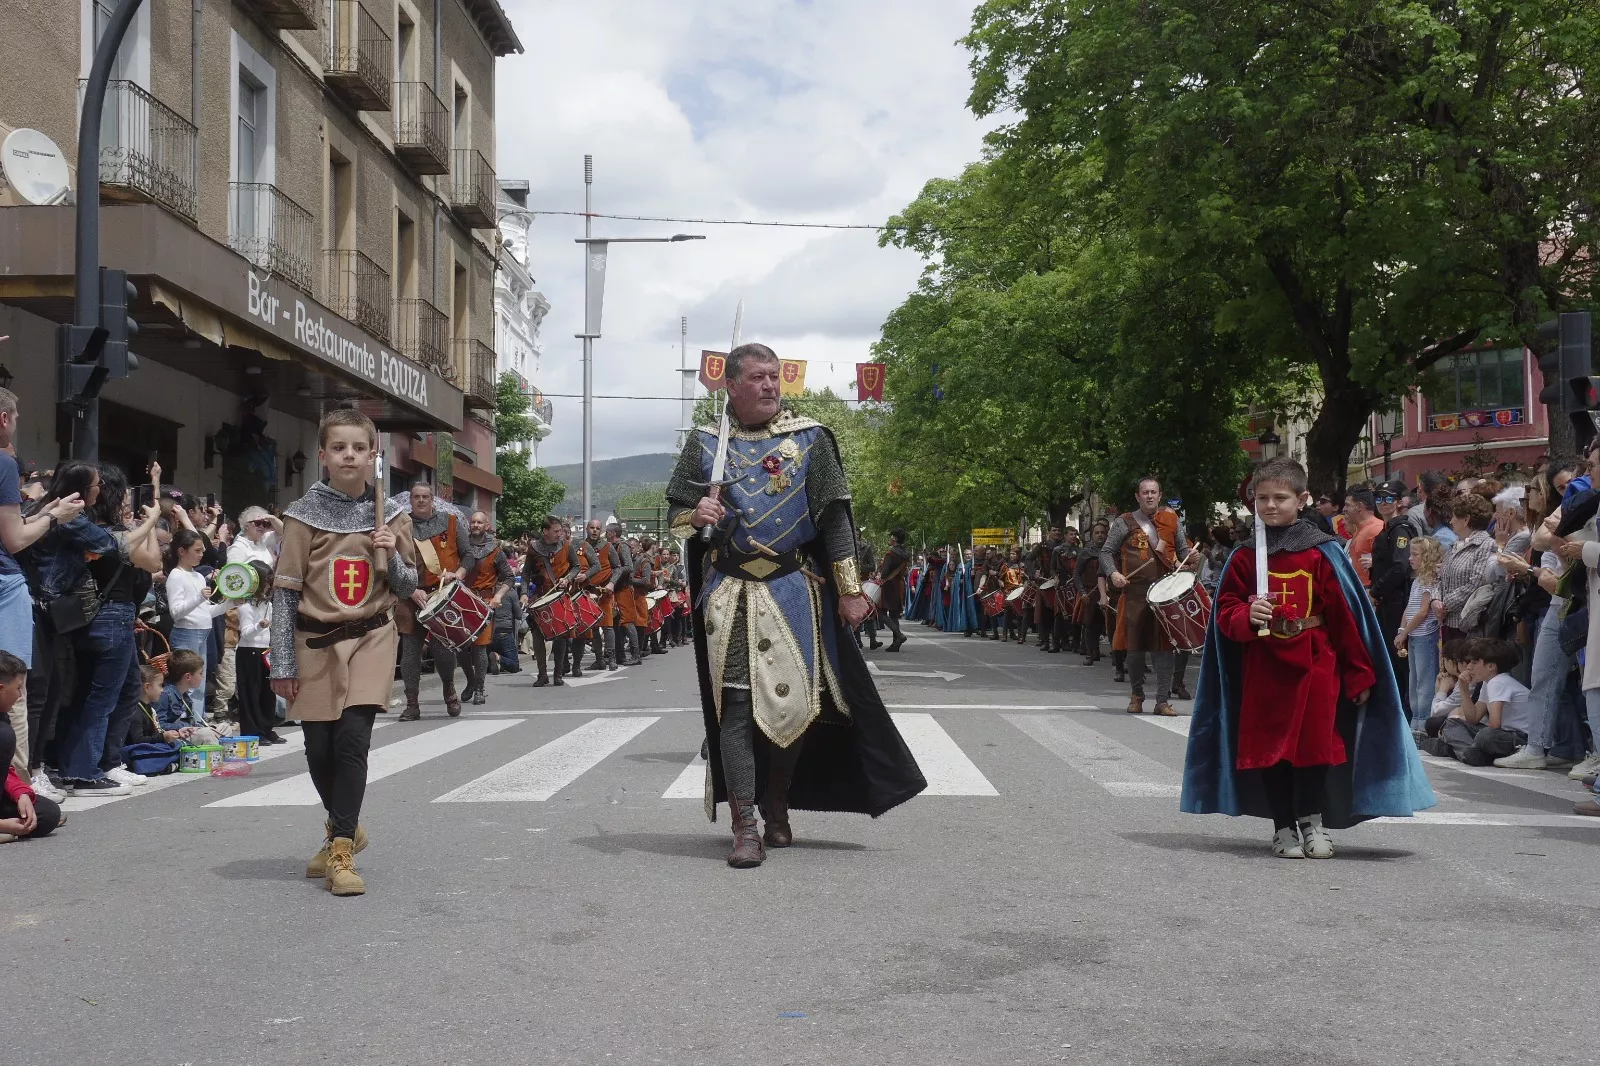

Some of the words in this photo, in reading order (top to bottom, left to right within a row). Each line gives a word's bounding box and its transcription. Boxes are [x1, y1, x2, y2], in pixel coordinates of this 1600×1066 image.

[248, 270, 280, 326] Bar
[295, 299, 375, 379] Restaurante
[380, 350, 429, 406] EQUIZA
